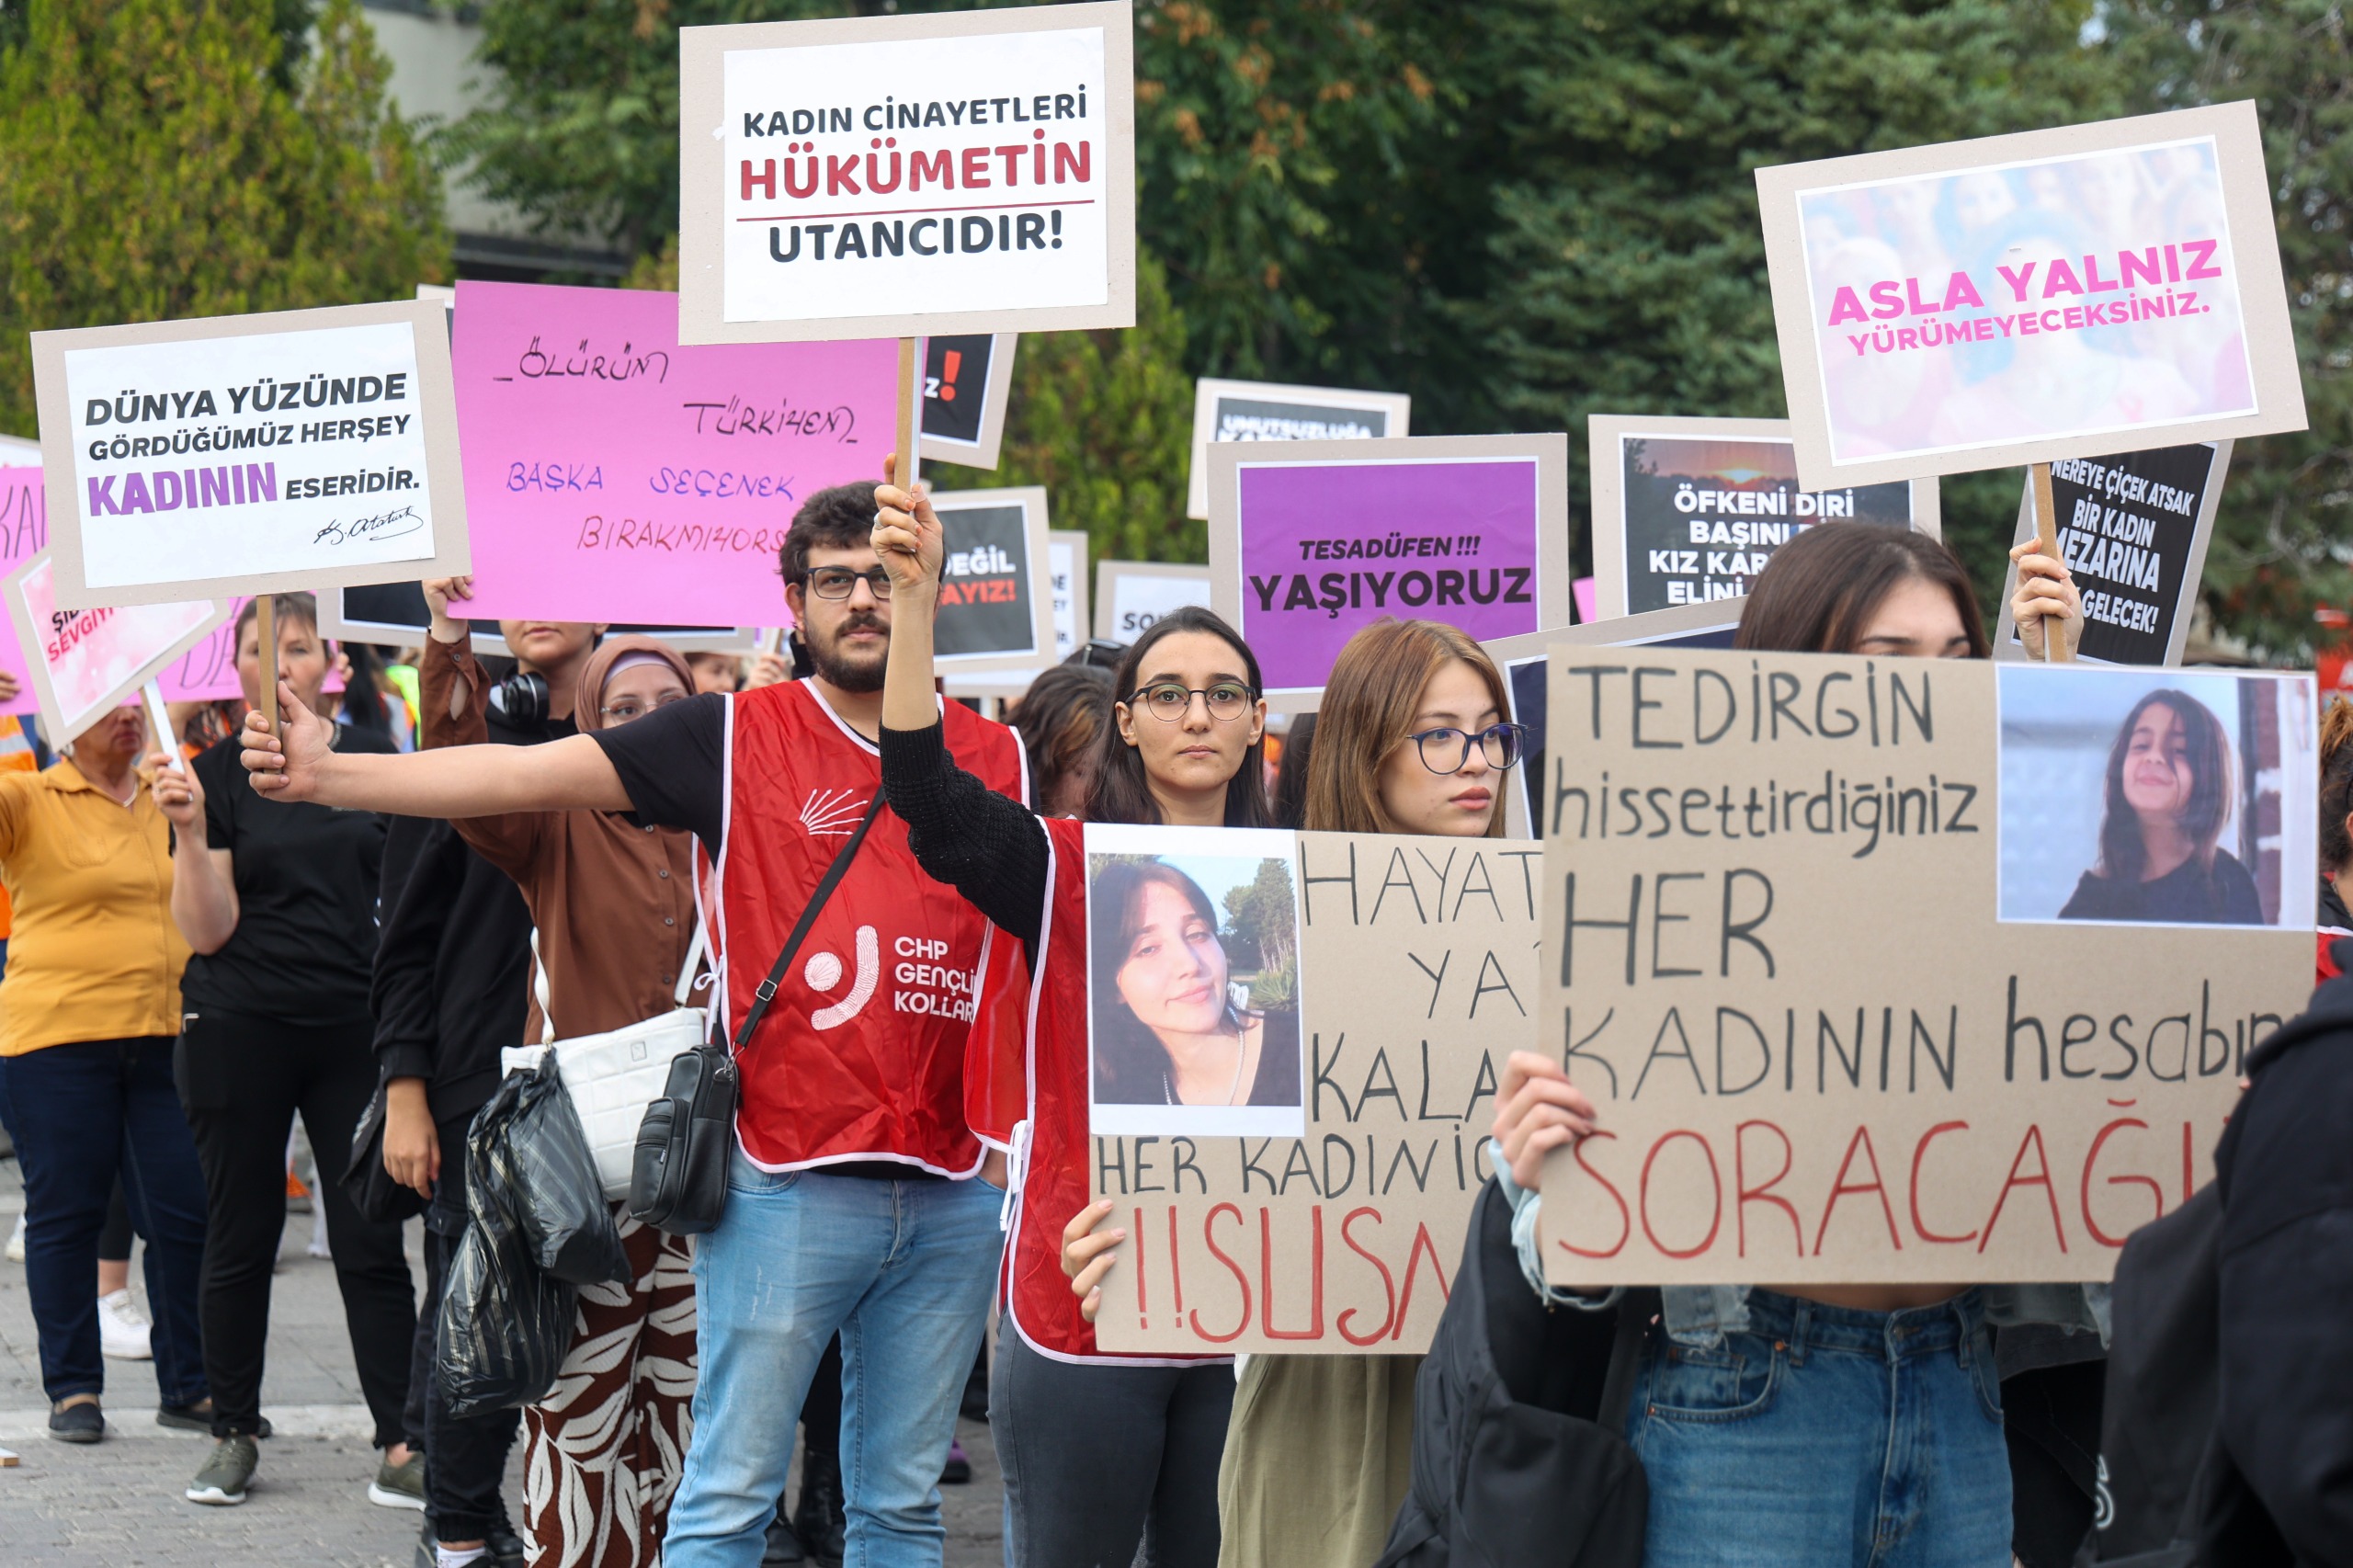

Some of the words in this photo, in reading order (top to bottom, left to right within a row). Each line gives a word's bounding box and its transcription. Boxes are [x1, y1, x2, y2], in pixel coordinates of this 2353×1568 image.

[744, 107, 853, 138] KADIN
[863, 84, 1087, 131] CİNAYETLERİ
[740, 128, 1092, 201] HÜKÜMETİN
[768, 210, 1063, 263] UTANCIDIR!
[1828, 271, 1985, 326] ASLA
[1996, 239, 2222, 302] YALNIZ
[1847, 288, 2211, 357] YÜRÜMEYECEKSİNİZ.
[85, 389, 217, 426] DÜNYA
[227, 372, 407, 413] YÜZÜNDE
[88, 423, 294, 460] GÖRDÜĞÜMÜZ
[300, 414, 413, 445] HERŞEY
[87, 462, 278, 517] KADININ
[285, 466, 421, 500] ESERİDİR.
[506, 461, 603, 493] BAŞKA
[650, 467, 795, 502] SEÇENEK
[1674, 483, 1788, 516] ÖFKENİ
[1794, 488, 1855, 517] DİRİ
[2051, 459, 2106, 490] NEREYE
[2105, 465, 2149, 505] ÇİÇEK
[2146, 483, 2195, 517] ATSAK
[1299, 532, 1452, 560] TESADÜFEN
[1689, 520, 1790, 550] BAŞINI
[2072, 494, 2102, 533] BİR
[2101, 507, 2156, 549] KADIN
[1649, 550, 1699, 574] KIZ
[1707, 551, 1772, 575] KAR
[1249, 567, 1531, 619] YAŞIYORUZ
[2082, 588, 2159, 634] GELECEK!
[1569, 659, 1933, 749] TEDİRGİN
[1552, 756, 1980, 858] hissettirdiğiniz
[1301, 841, 1544, 926] HAYAT
[894, 937, 949, 960] CHP
[1560, 869, 1776, 988] HER
[895, 962, 976, 996] GENÇLİ
[1407, 940, 1541, 1019] YA
[894, 991, 974, 1024] KOLLAR
[1563, 1005, 1958, 1101] KADININ
[1097, 1136, 1207, 1195] HER
[1239, 1134, 1439, 1199] KADIN
[1559, 1098, 2231, 1260] SORACAĞI
